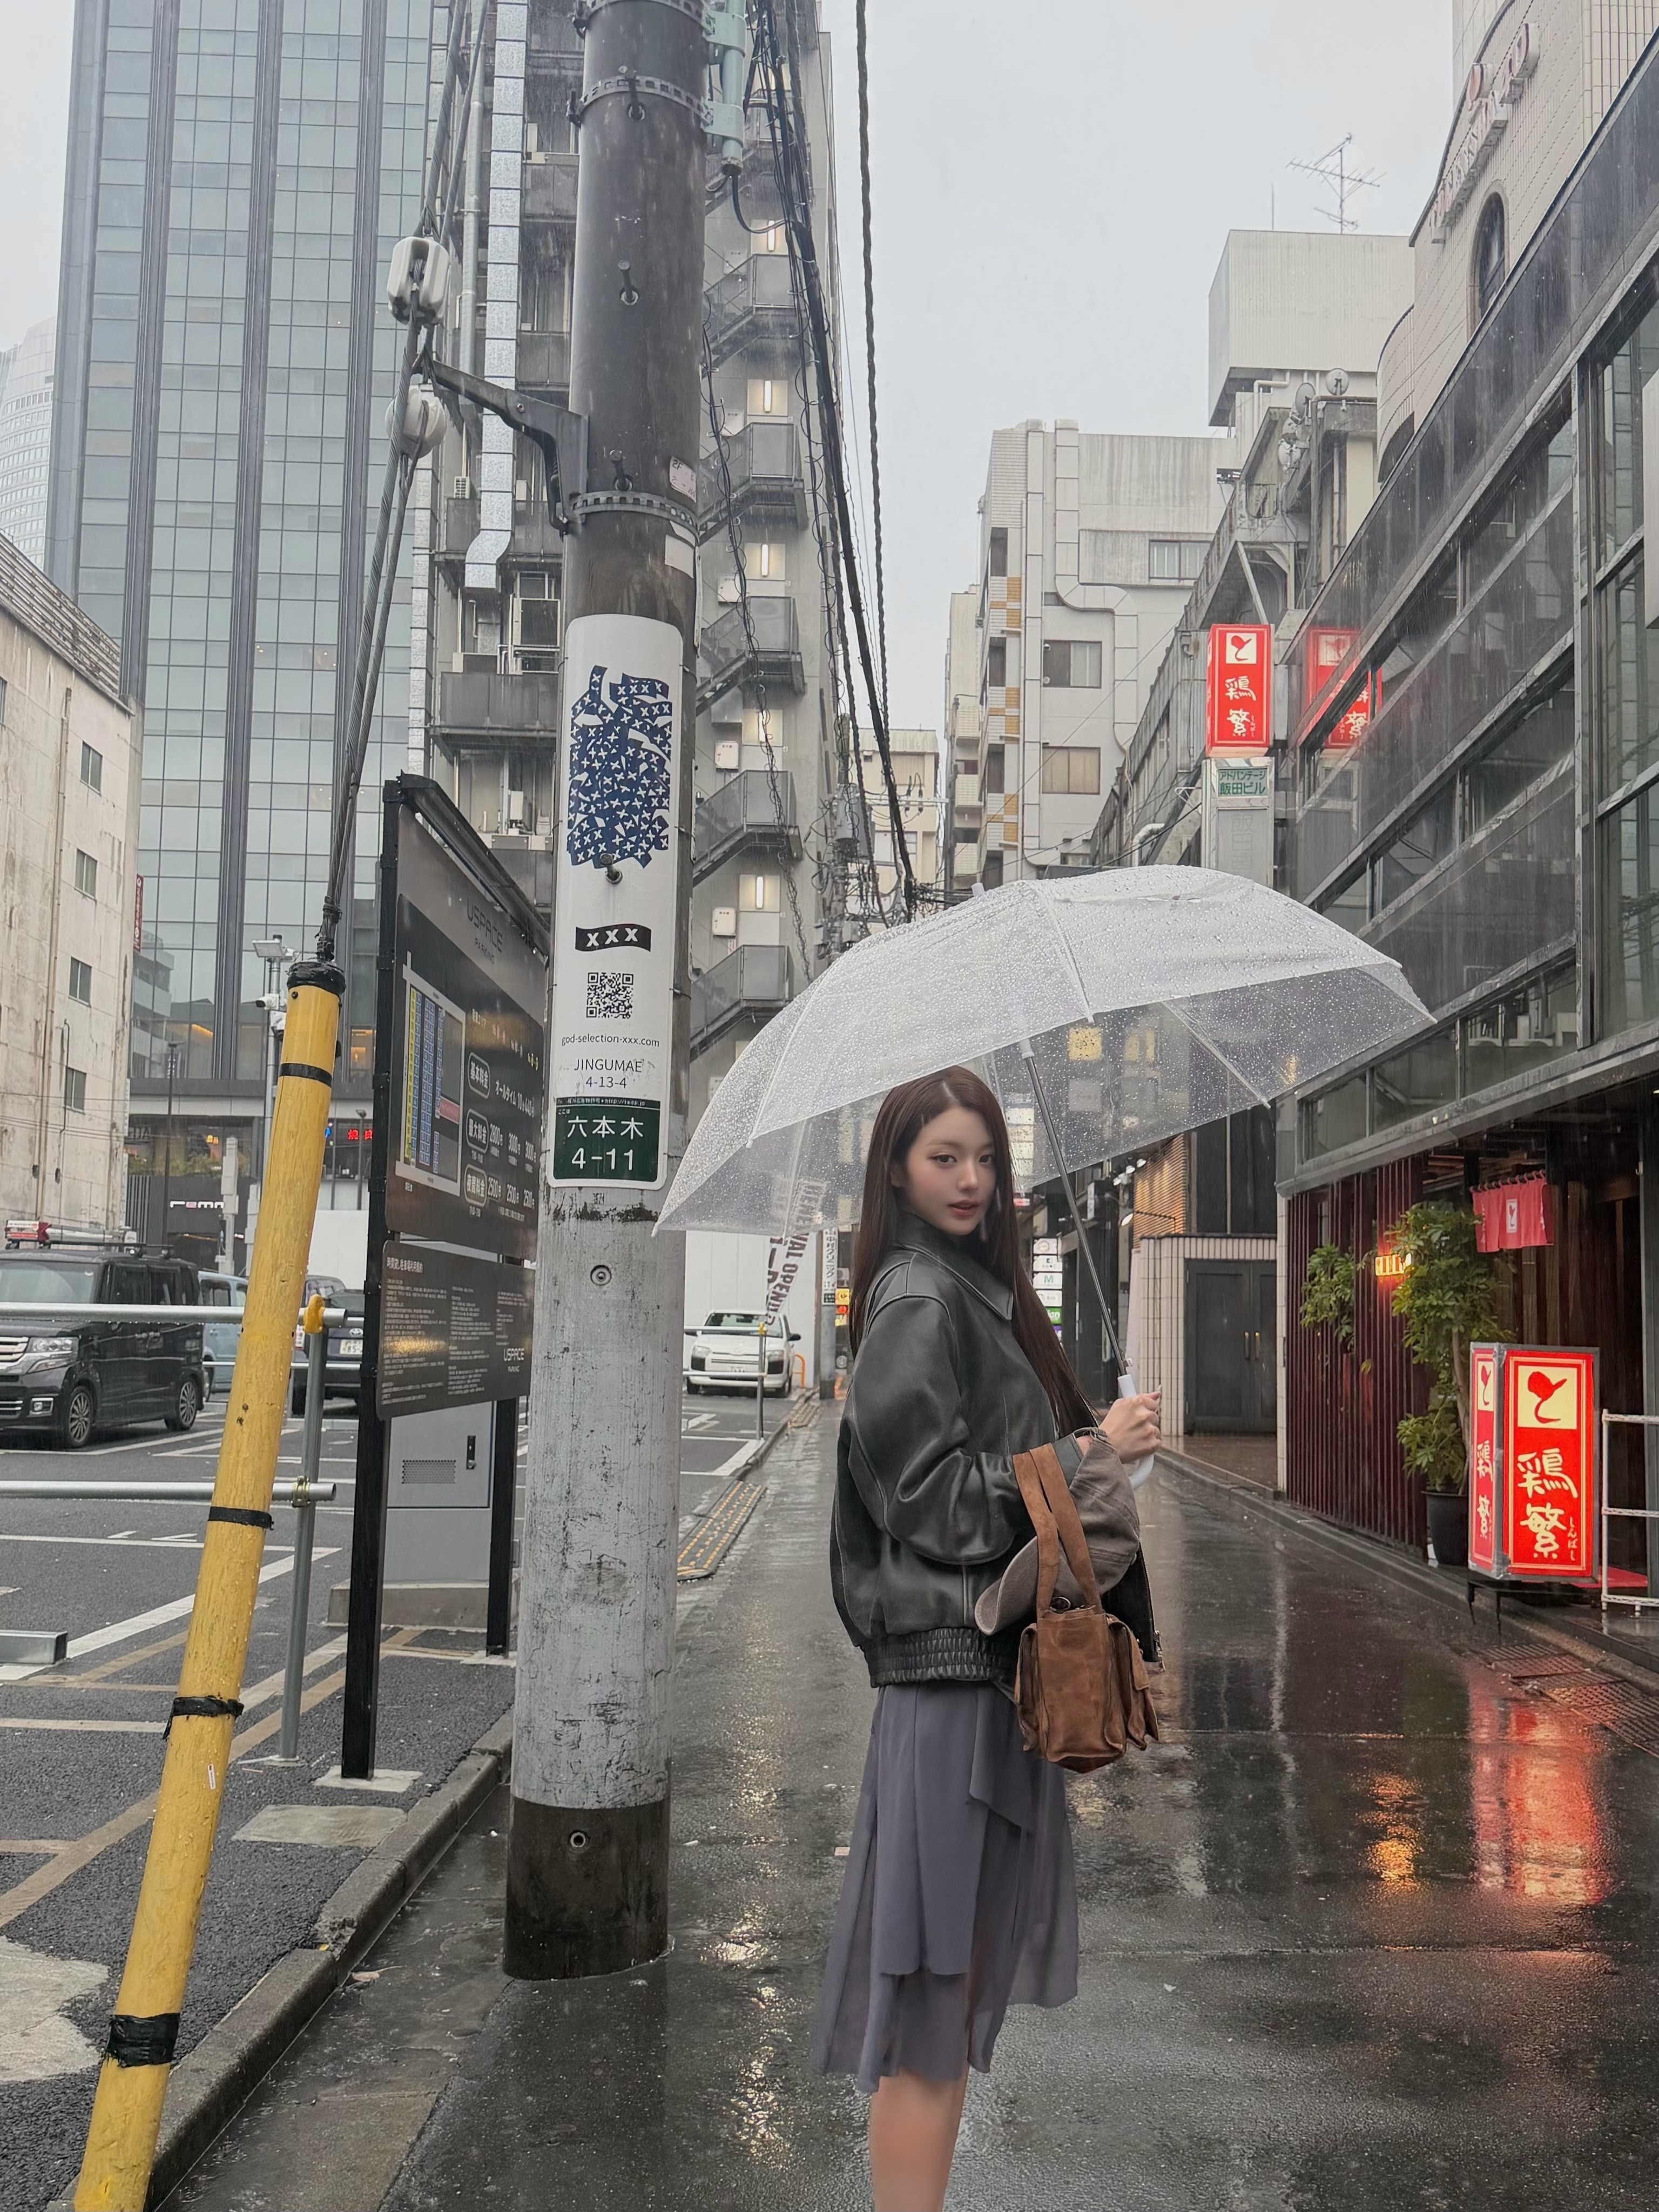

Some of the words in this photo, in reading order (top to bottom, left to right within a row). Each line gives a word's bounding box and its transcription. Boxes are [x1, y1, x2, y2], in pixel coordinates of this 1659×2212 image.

[1219, 770, 1266, 781] アドバンテージ
[1220, 782, 1265, 796] 飯田ビル
[467, 898, 502, 953] USPACE
[586, 928, 638, 947] XXX
[562, 1034, 659, 1048] god-selection-xxx.com
[470, 1061, 488, 1089] 基本料金
[574, 1059, 643, 1073] JINGUMAE
[495, 1080, 516, 1106] オールタイム
[585, 1076, 627, 1089] 4-13-4
[469, 1118, 486, 1144] 最大料金
[568, 1115, 644, 1139] 六本木
[572, 1148, 633, 1170] 4-11
[467, 1174, 484, 1197] 夜間料金
[826, 1236, 835, 1278] 中村クリニック
[504, 1348, 524, 1361] USPACE
[1517, 1448, 1578, 1559] 鶏繁
[1568, 1517, 1578, 1561] しんばし
